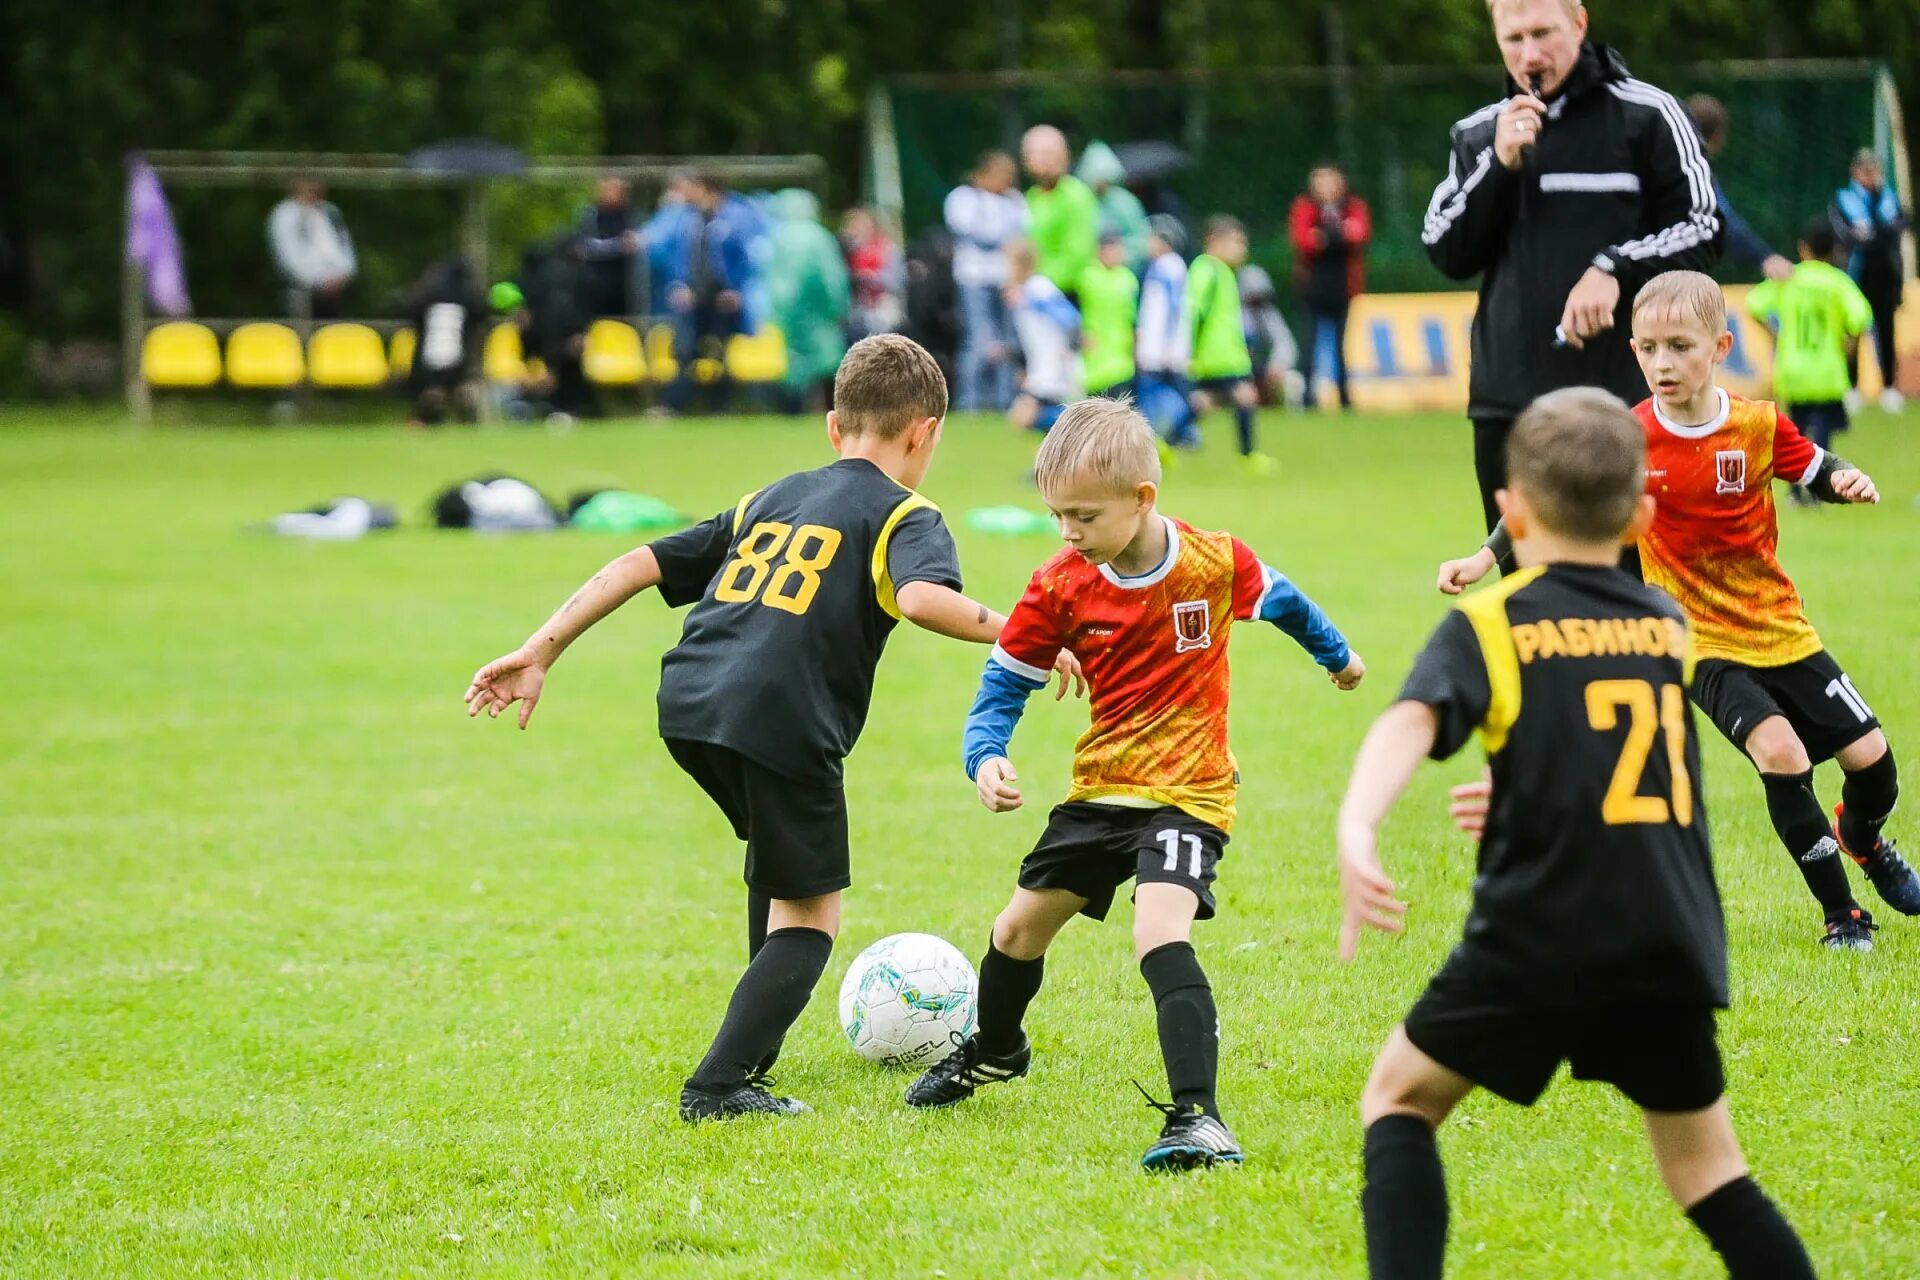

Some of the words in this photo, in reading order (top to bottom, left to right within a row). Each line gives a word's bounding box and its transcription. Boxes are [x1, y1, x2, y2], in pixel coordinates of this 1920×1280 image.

[714, 521, 842, 615] 88
[1584, 678, 1692, 828] 21
[1156, 828, 1203, 880] 11
